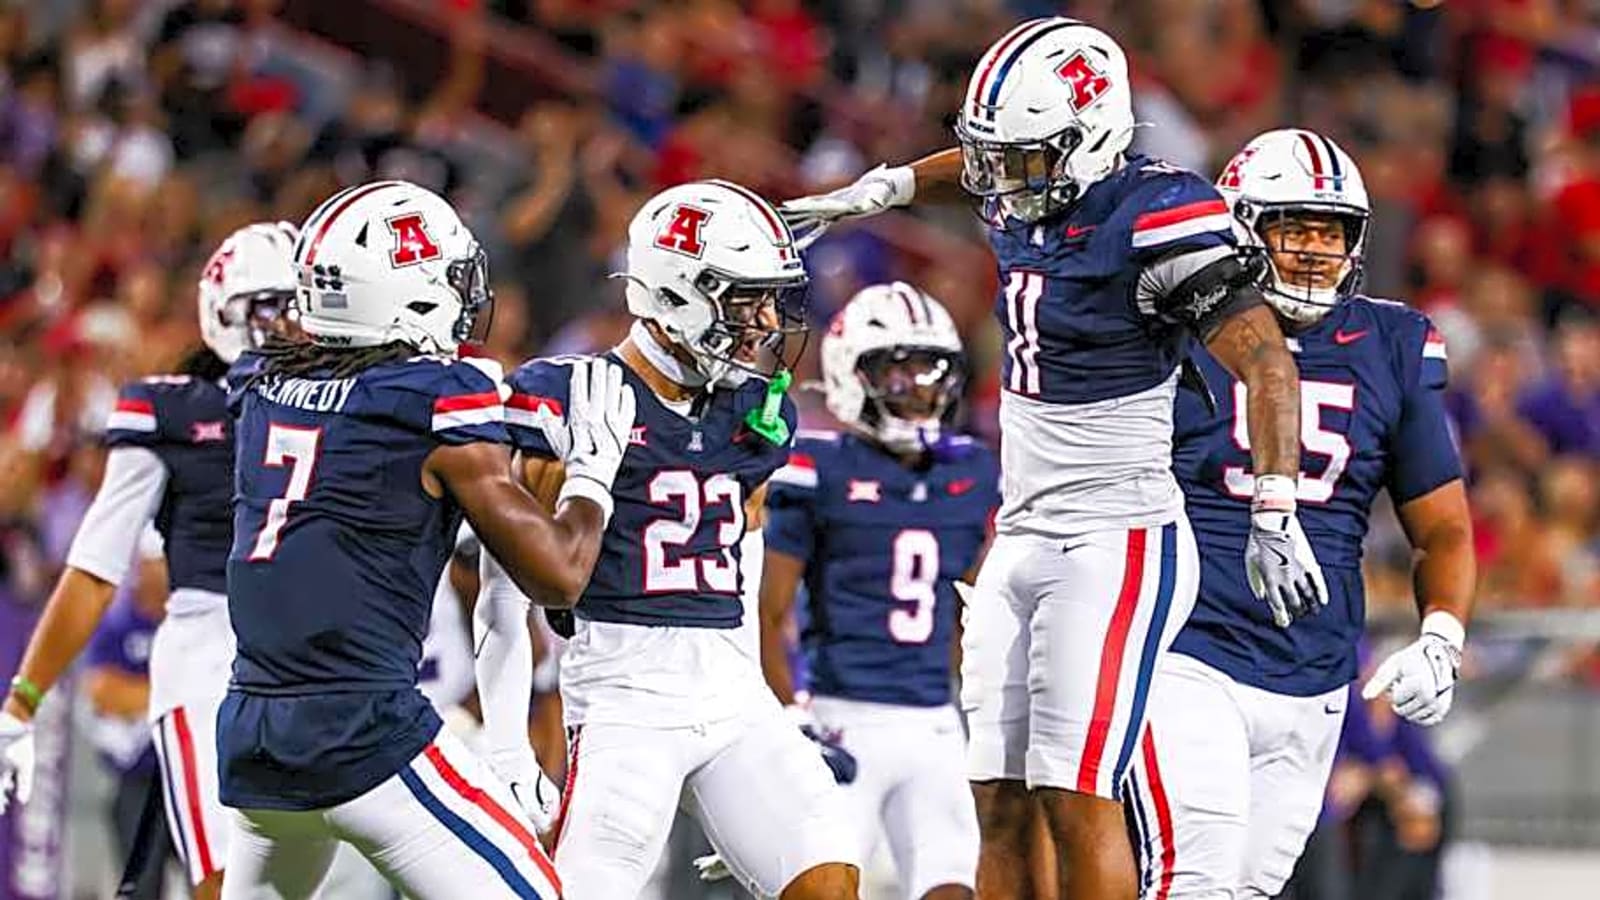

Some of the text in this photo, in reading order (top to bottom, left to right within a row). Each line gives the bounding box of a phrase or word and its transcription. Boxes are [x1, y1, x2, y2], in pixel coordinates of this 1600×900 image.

[1054, 50, 1112, 115] A
[385, 211, 443, 269] A
[653, 203, 713, 260] A
[1003, 267, 1045, 398] 11
[247, 422, 322, 563] 7
[643, 468, 745, 594] 23
[888, 528, 940, 645] 9
